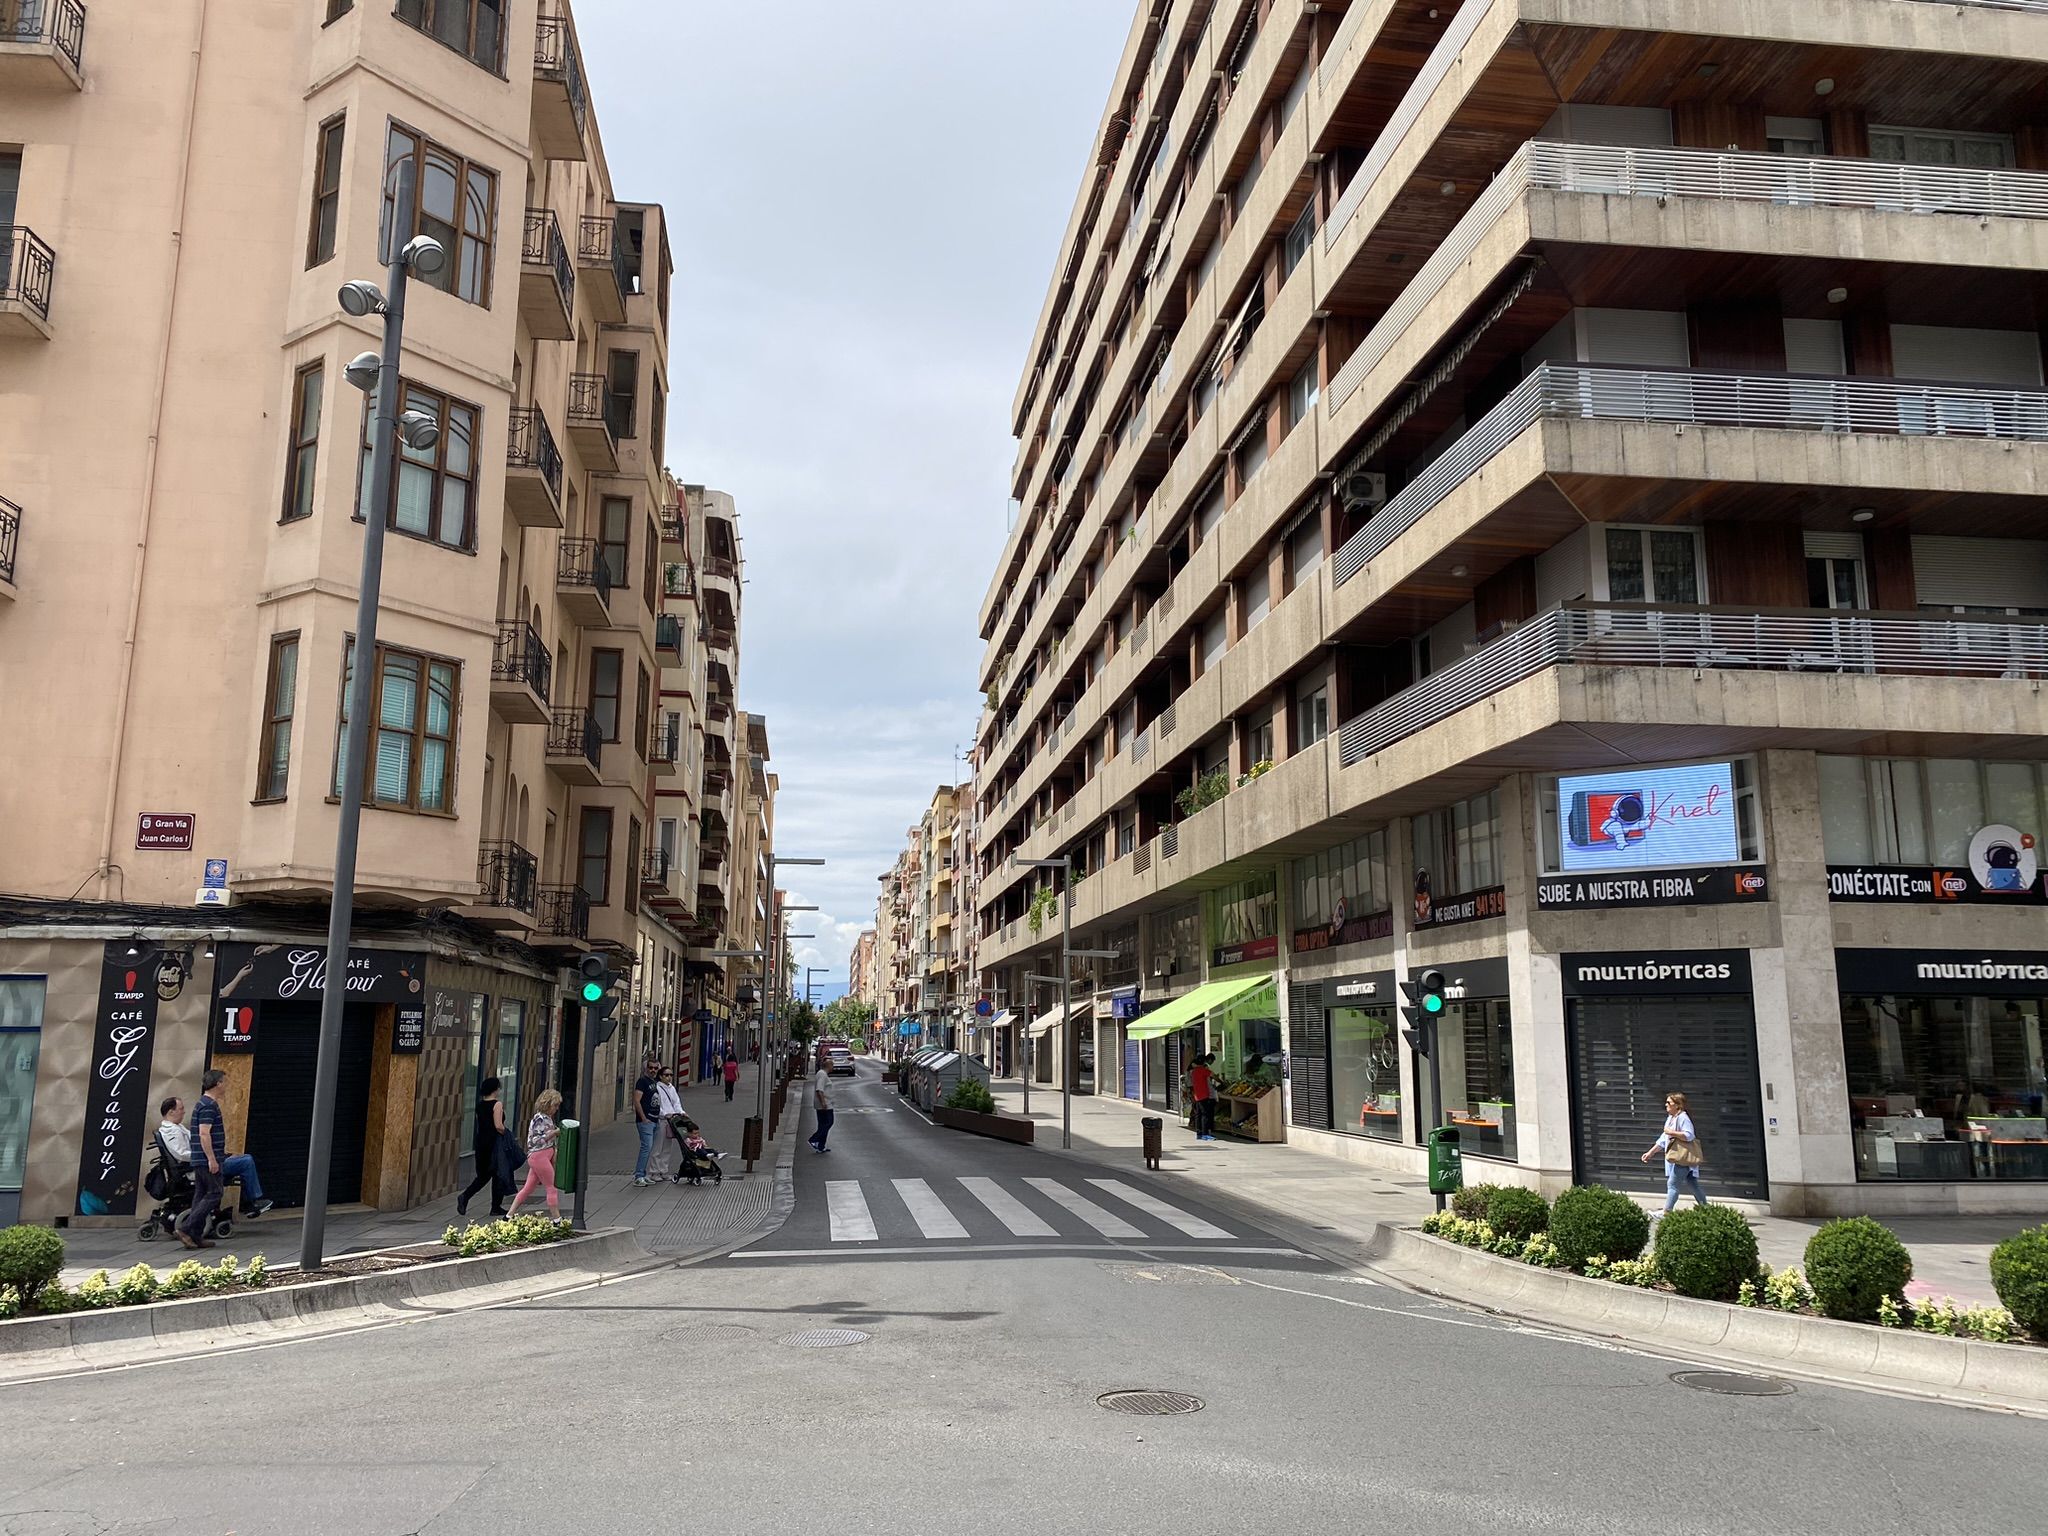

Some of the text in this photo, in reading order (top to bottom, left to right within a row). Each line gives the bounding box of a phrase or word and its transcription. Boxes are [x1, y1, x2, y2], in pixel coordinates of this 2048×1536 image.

[1649, 784, 1728, 830] Knet
[155, 820, 174, 828] Gran
[140, 834, 158, 842] Juan
[159, 834, 183, 842] Carlos
[1538, 877, 1694, 904] SUBE A NUESTRA FIBRA
[1911, 879, 1932, 892] CON
[1443, 904, 1461, 921] GUSTA
[347, 958, 370, 969] AFÉ
[114, 992, 144, 1000] TEMPLO
[111, 1010, 143, 1020] CAFÉ
[223, 1007, 239, 1034] I
[99, 1026, 147, 1181] Glamour
